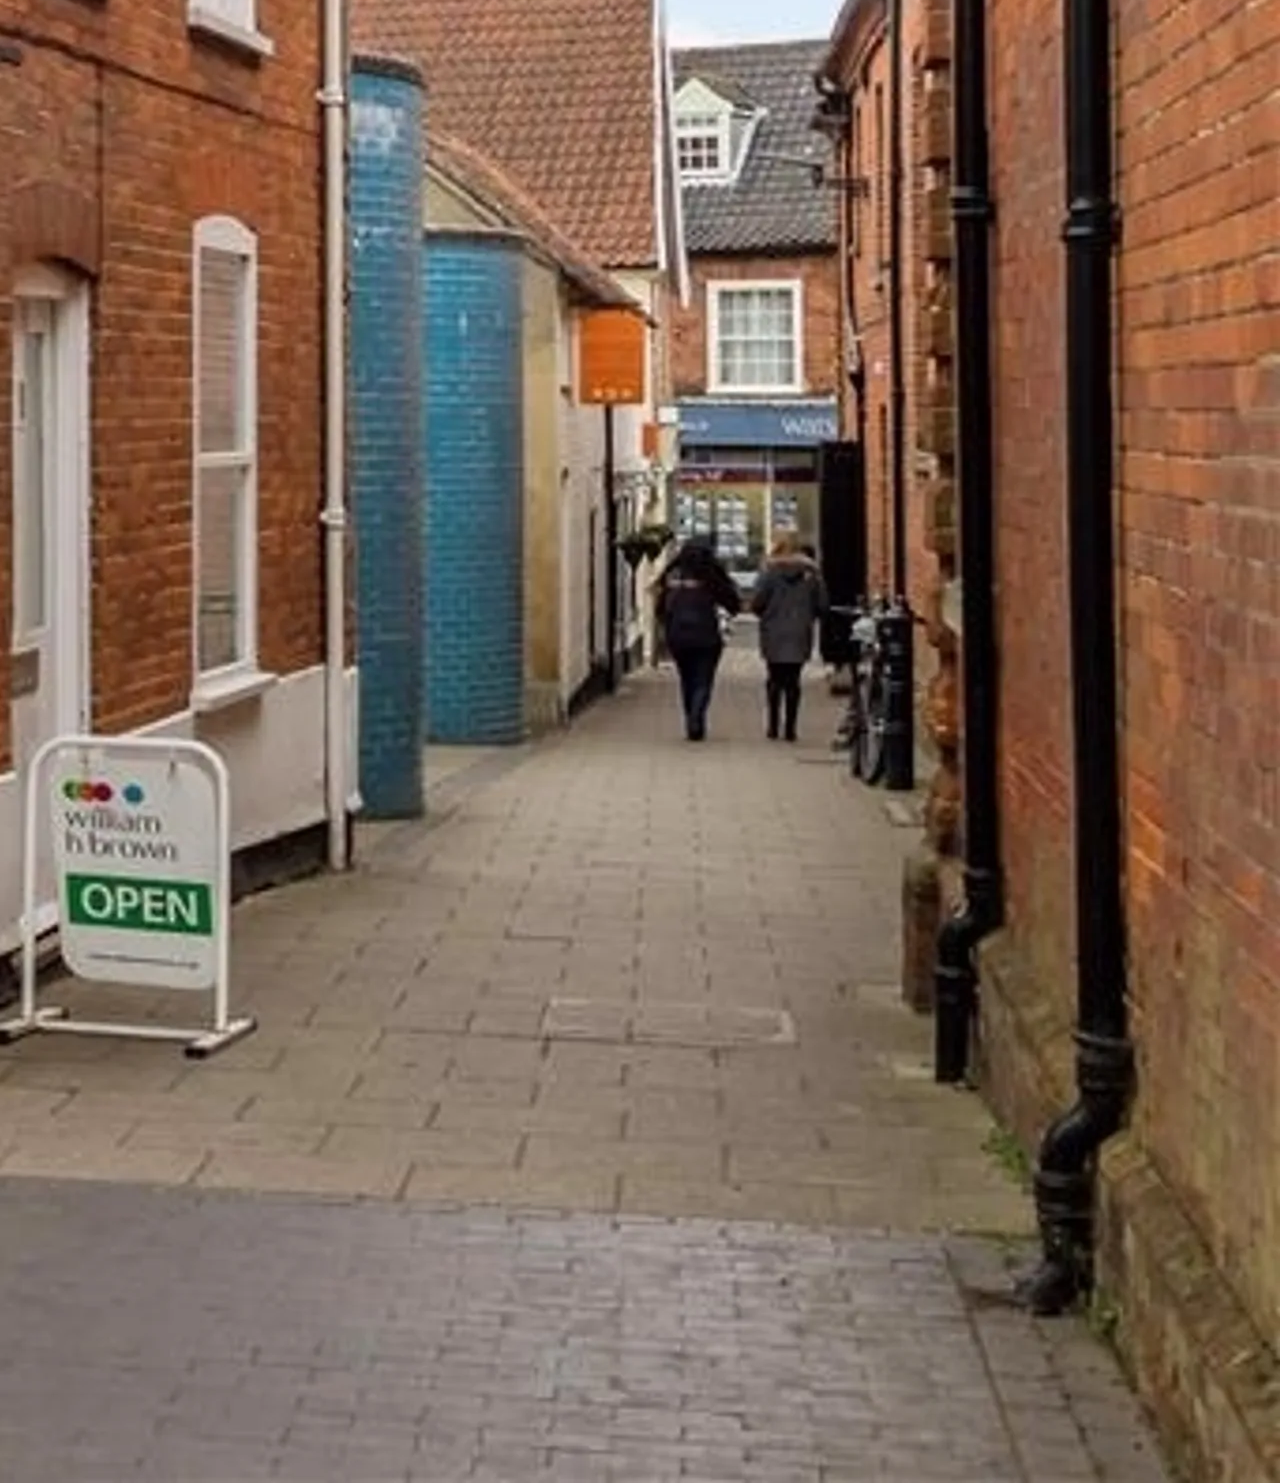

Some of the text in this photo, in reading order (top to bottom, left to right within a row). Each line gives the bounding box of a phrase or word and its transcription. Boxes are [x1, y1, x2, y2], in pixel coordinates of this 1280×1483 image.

[64, 807, 161, 834] william
[64, 832, 178, 862] h brown
[80, 883, 199, 926] OPEN
